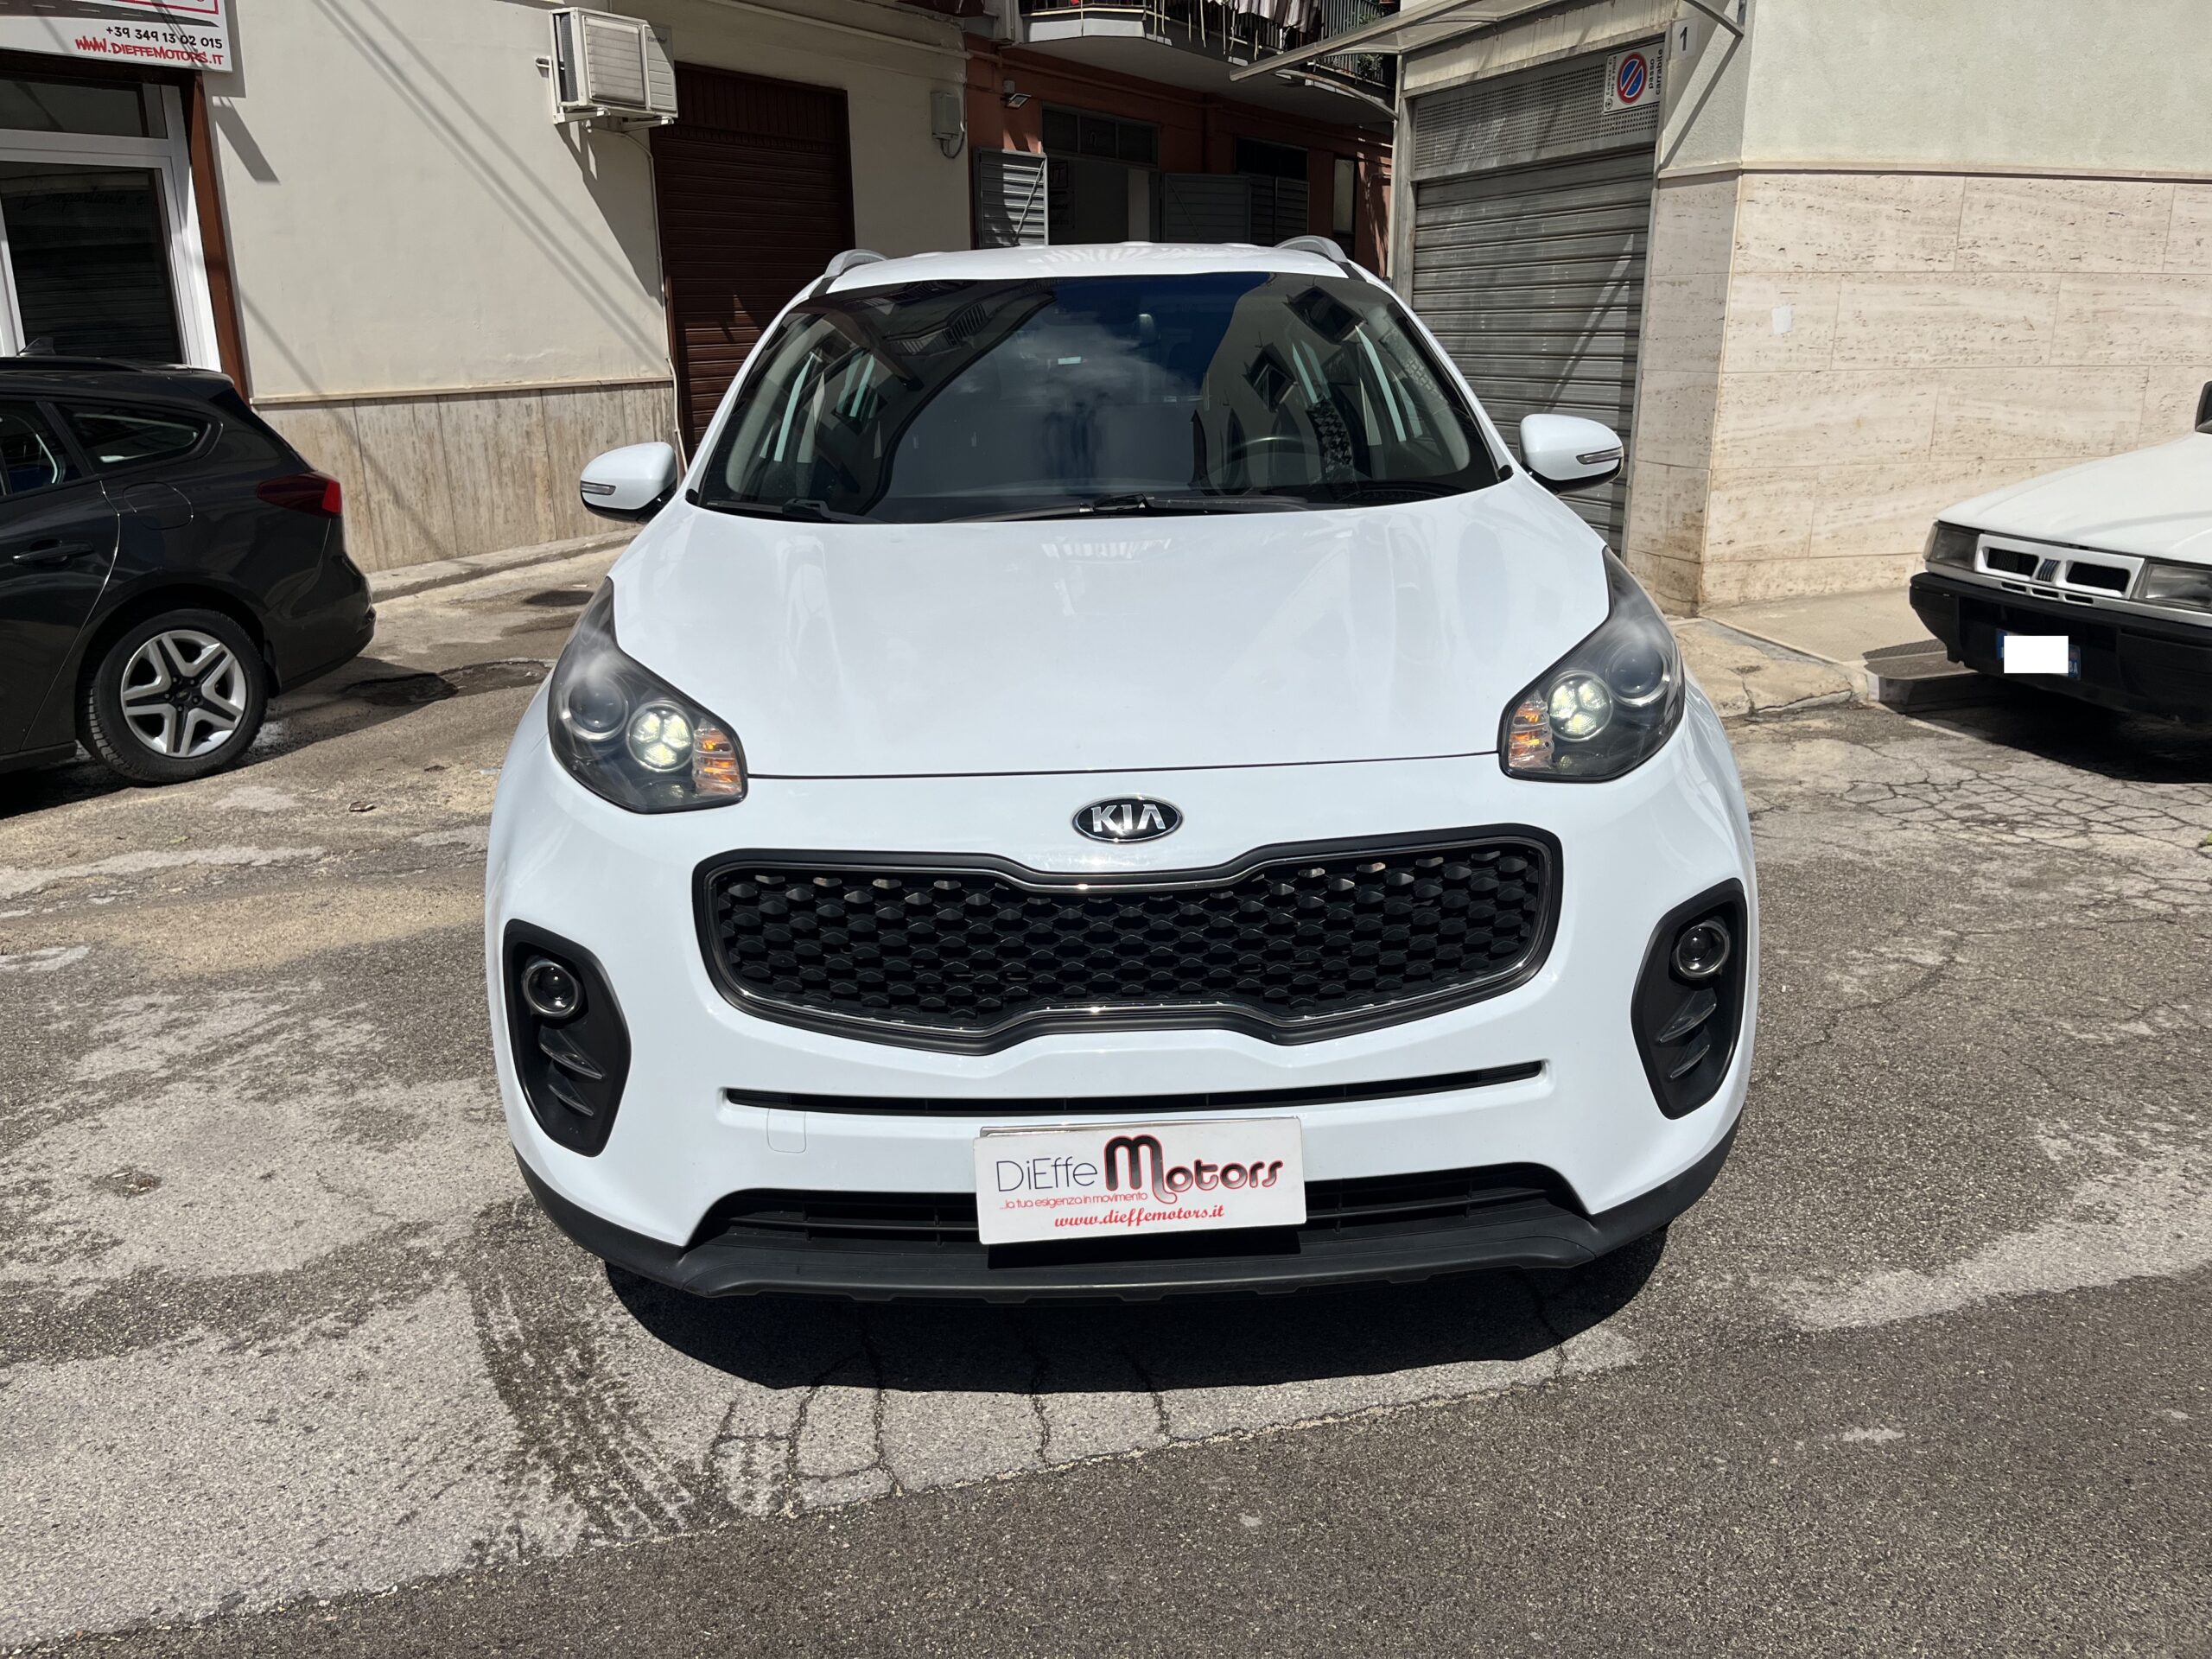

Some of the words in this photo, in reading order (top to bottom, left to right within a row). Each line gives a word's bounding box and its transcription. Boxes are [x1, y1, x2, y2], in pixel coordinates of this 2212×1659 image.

[74, 35, 224, 66] WWW.DIEFFEMOTORS.IT
[105, 26, 130, 39] +39
[135, 29, 159, 42] 349
[162, 32, 176, 44] 13
[180, 35, 197, 47] 02
[200, 37, 223, 49] 015
[1679, 26, 1688, 52] 1
[1090, 804, 1166, 833] KIA
[996, 1155, 1098, 1192] DiEffe
[1103, 1134, 1284, 1205] Motors
[1016, 1198, 1033, 1209] tua
[1034, 1196, 1082, 1209] esigenza
[1082, 1193, 1092, 1205] in
[1093, 1191, 1148, 1204] movimento
[1053, 1204, 1224, 1228] www.dieffemotors.it
